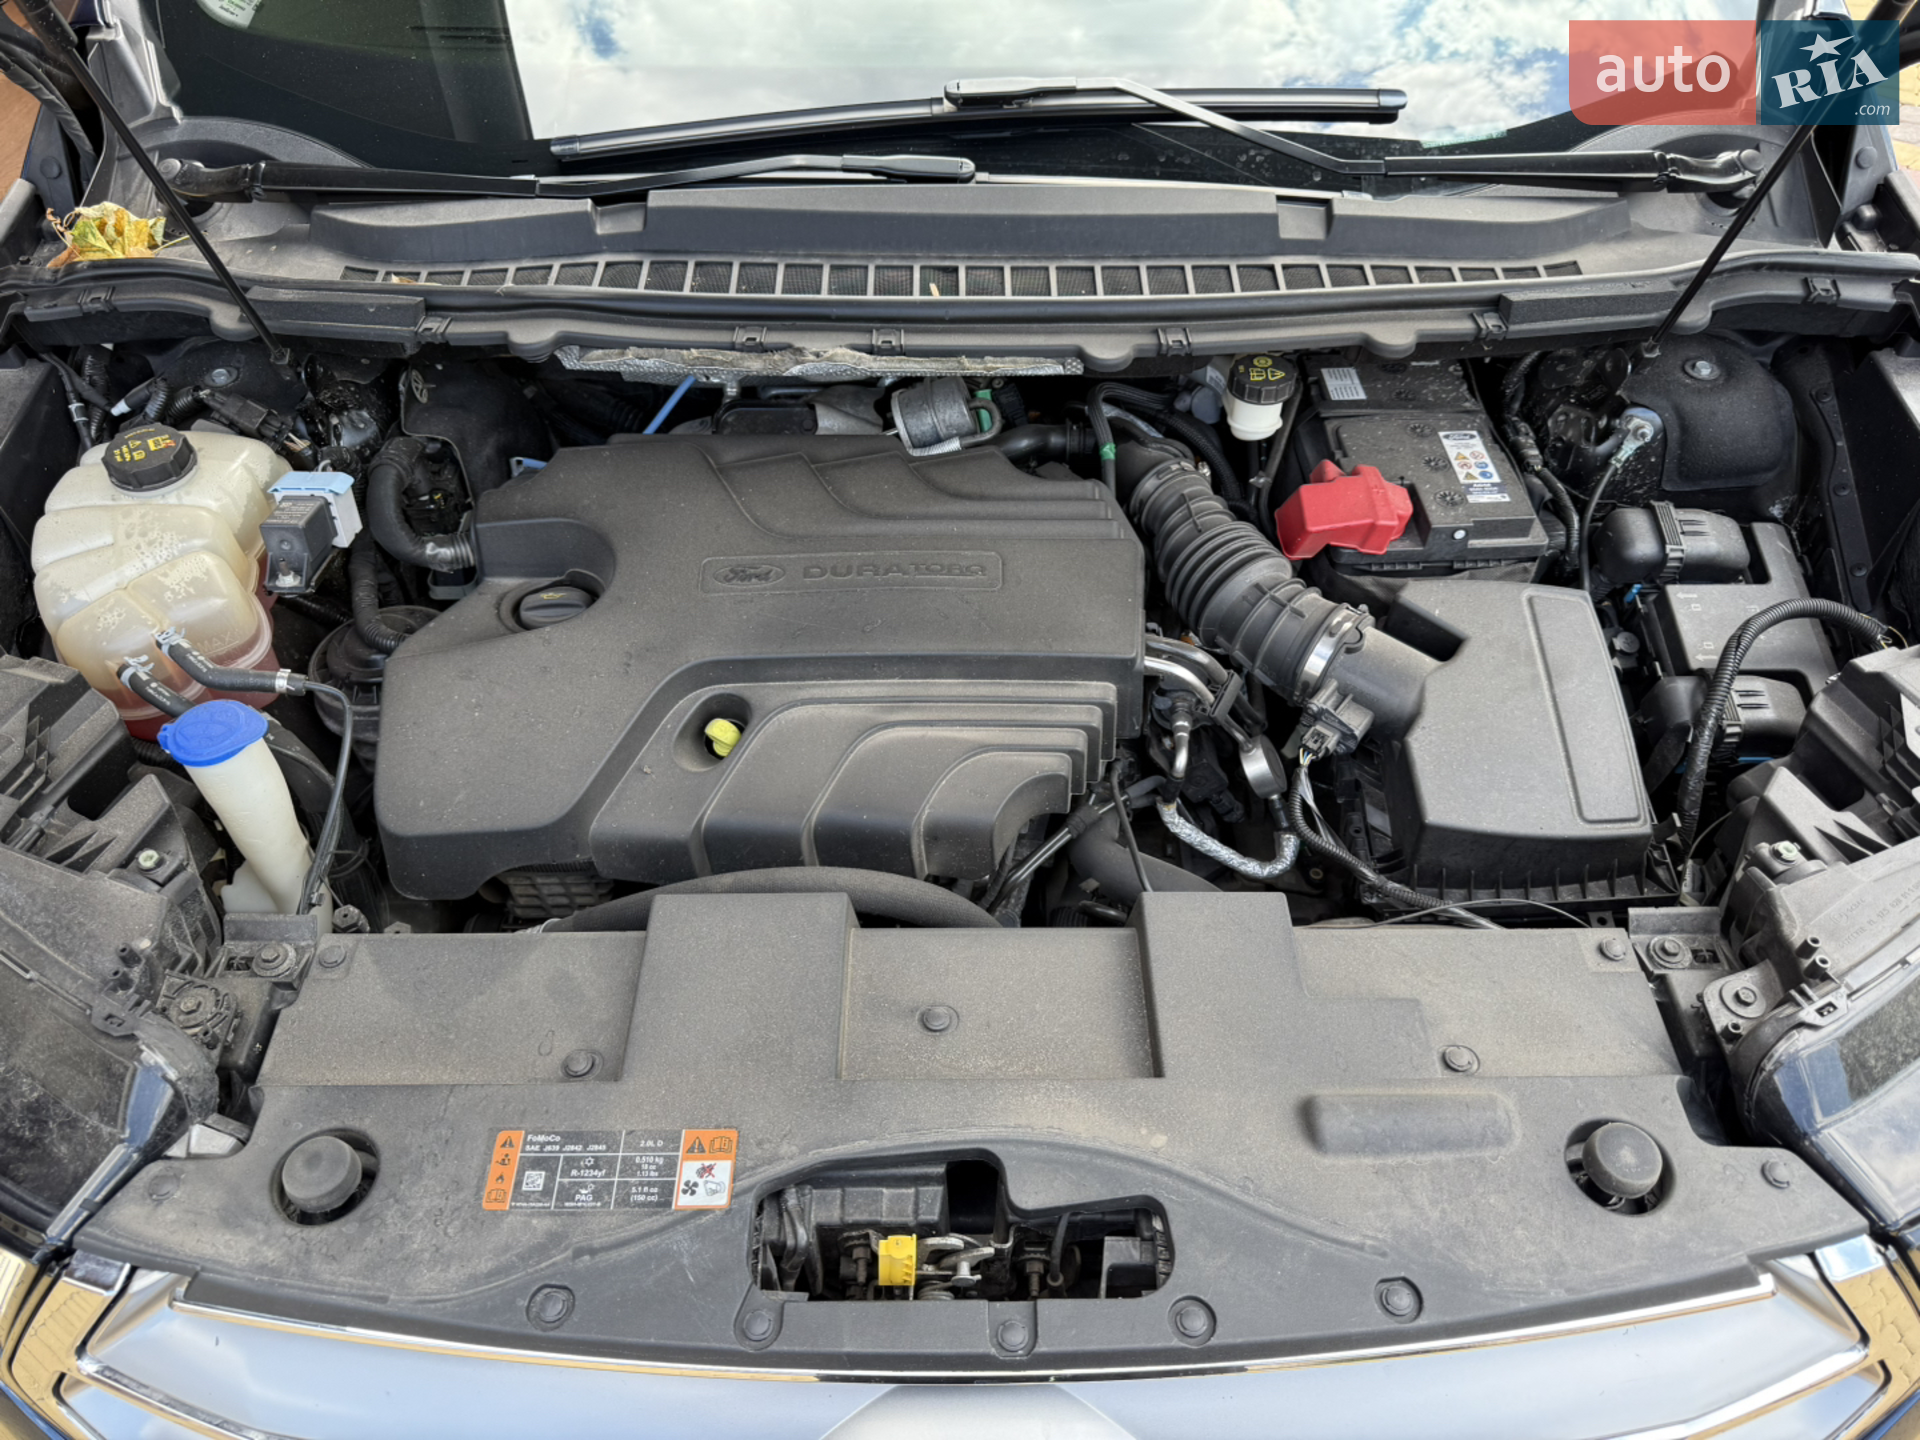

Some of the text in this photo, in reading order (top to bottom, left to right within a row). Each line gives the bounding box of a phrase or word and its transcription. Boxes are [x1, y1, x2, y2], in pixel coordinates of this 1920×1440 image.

[723, 563, 988, 584] Ford DURATORQ
[527, 1134, 561, 1143] FoMoCo
[571, 1169, 607, 1178] R-1234yf
[575, 1194, 593, 1202] PAG
